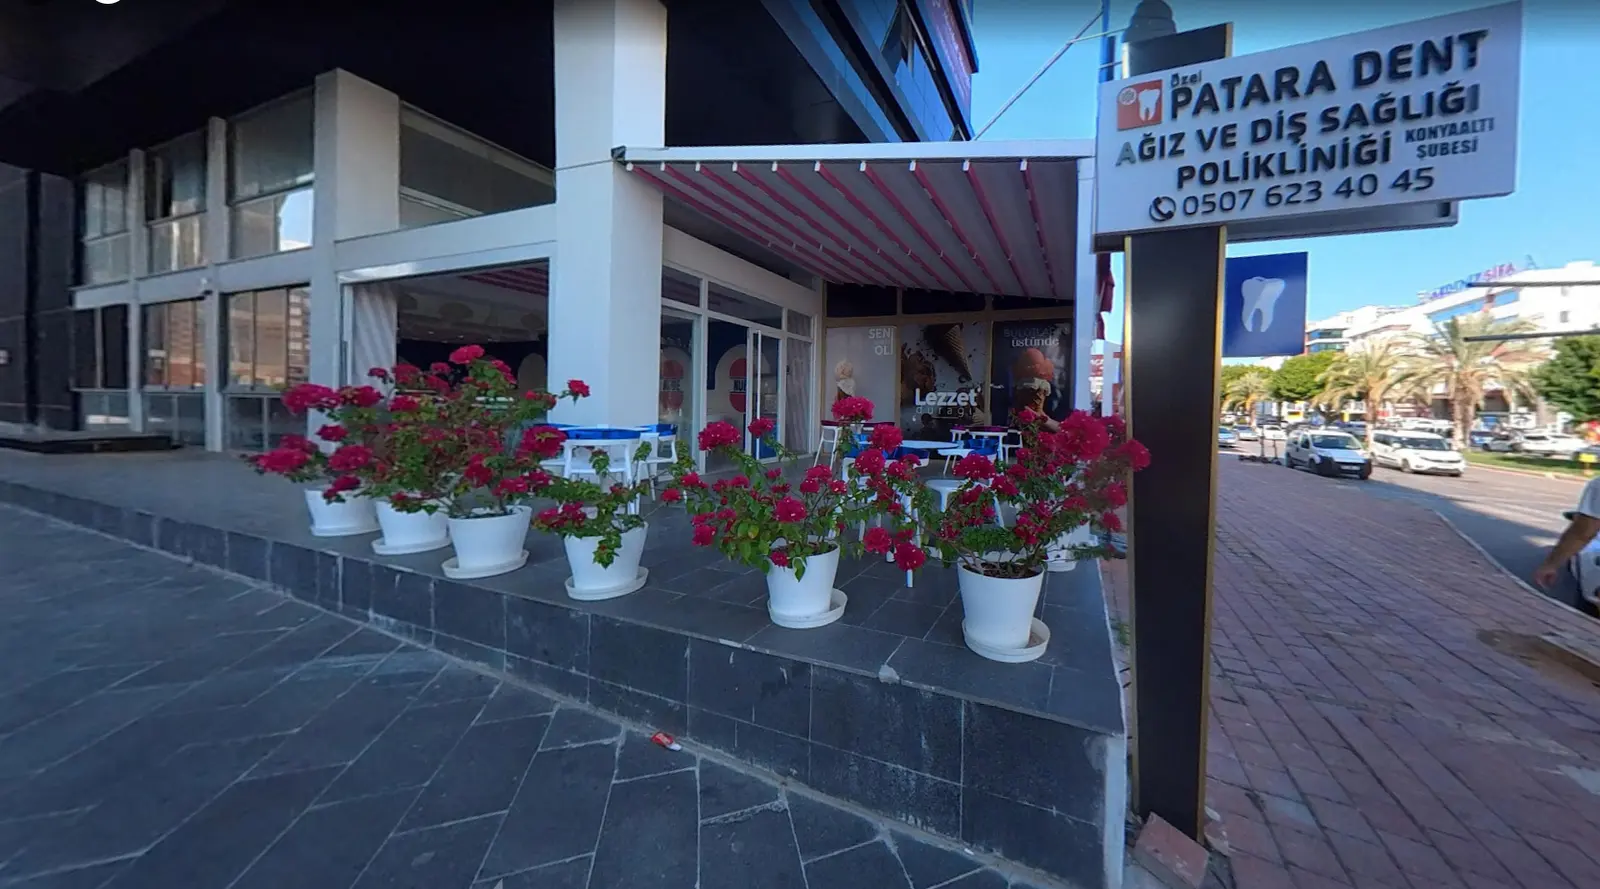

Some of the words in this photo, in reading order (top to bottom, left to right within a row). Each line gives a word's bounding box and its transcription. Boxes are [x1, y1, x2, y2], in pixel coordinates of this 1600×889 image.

[1171, 59, 1337, 120] PATARA
[1352, 28, 1489, 89] DENT
[1171, 71, 1203, 87] Özel
[1115, 132, 1186, 167] AĞIZ
[1195, 123, 1238, 151] VE
[1250, 109, 1308, 144] DİŞ
[1319, 80, 1481, 134] SAĞLIĞI
[1404, 117, 1496, 144] KONYAALTI
[1177, 131, 1391, 190] POLİKLİNİĞİ
[1416, 136, 1479, 161] ŞUBESİ
[1182, 188, 1255, 216] 0507
[1264, 181, 1323, 207] 623
[1333, 173, 1379, 199] 40
[1389, 166, 1435, 192] 45
[868, 327, 891, 339] SEN
[1011, 336, 1060, 347] üstünde
[915, 387, 978, 406] Lezzet
